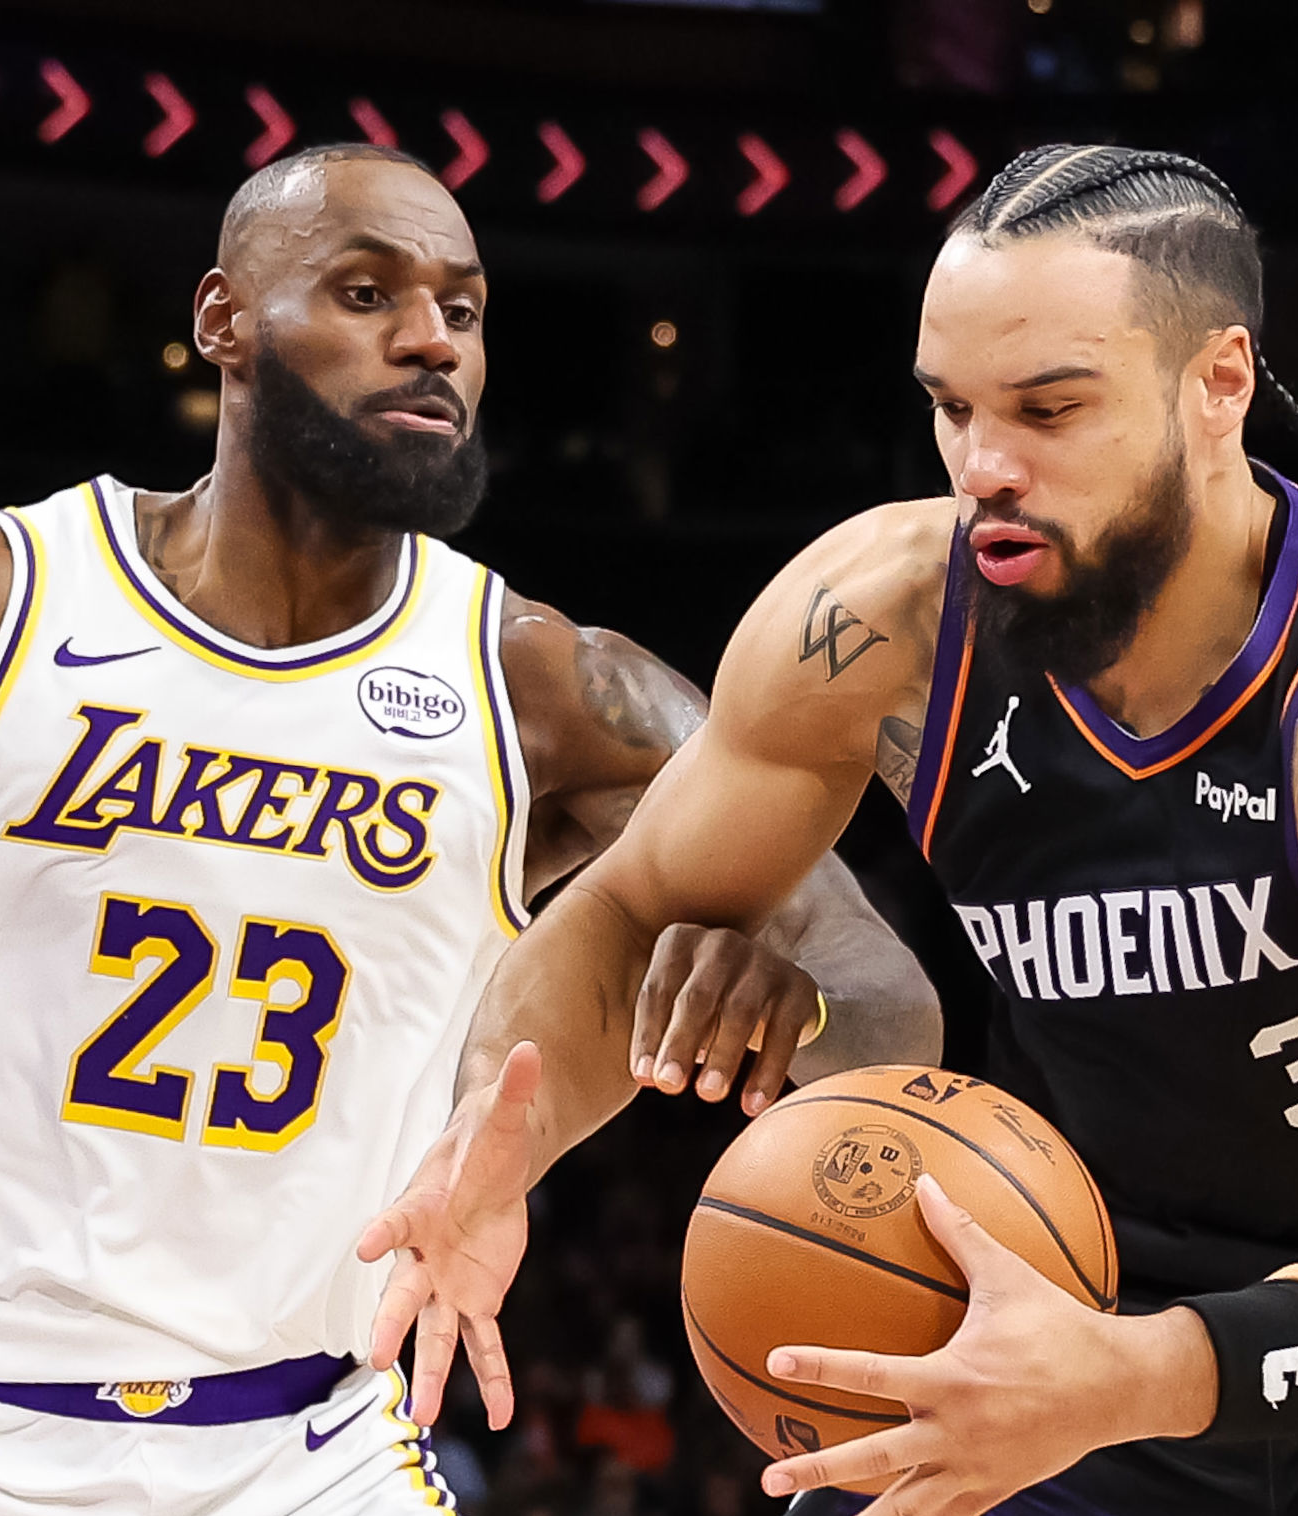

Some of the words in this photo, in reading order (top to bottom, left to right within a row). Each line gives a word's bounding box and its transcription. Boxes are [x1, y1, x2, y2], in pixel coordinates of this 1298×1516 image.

[368, 679, 459, 720] bibigo
[1195, 771, 1277, 823] PayPal
[60, 890, 353, 1154] 23
